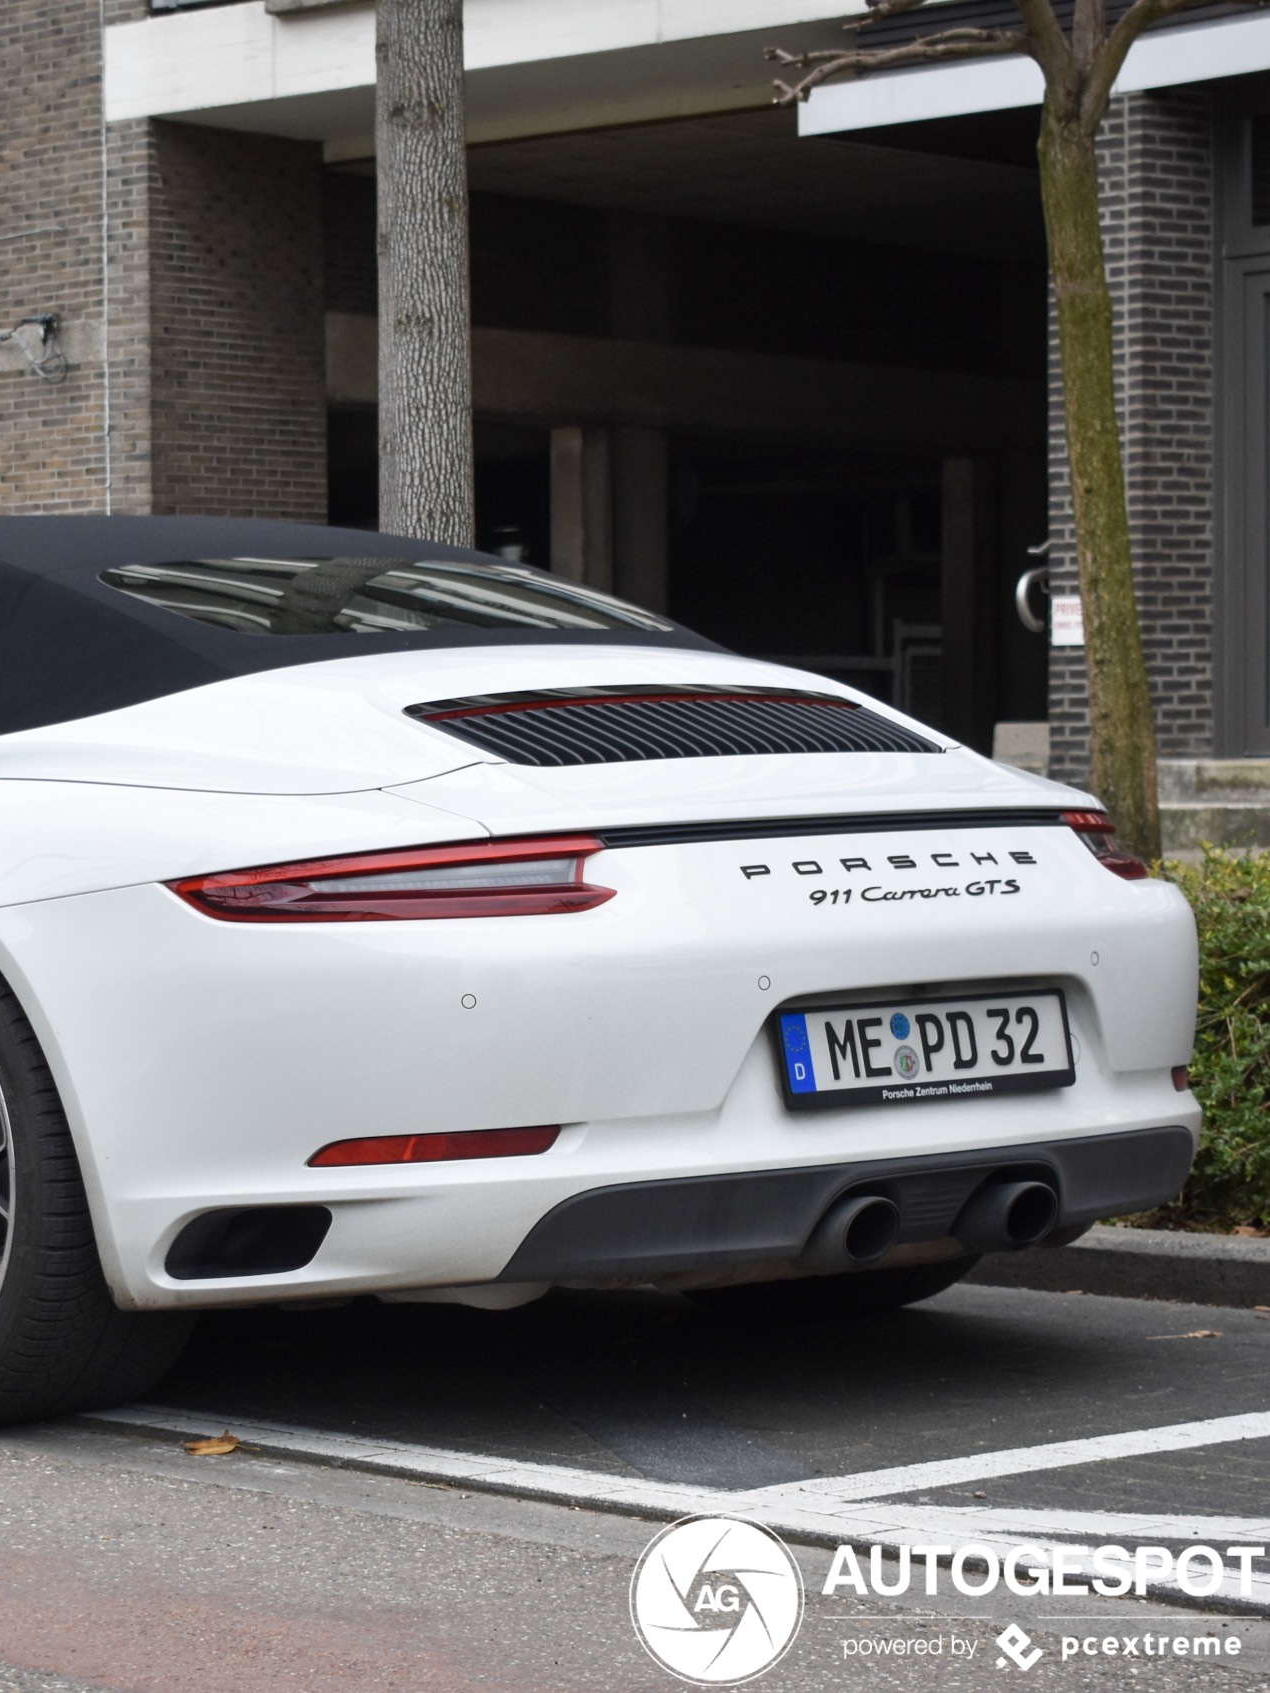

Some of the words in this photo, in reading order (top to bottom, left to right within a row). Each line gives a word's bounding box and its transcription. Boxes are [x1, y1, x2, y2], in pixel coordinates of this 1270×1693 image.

[740, 851, 1037, 880] PORSCHE
[809, 889, 853, 906] 911
[861, 886, 961, 902] Carrera
[965, 879, 1021, 896] GTS
[825, 1017, 892, 1081] ME
[915, 1011, 978, 1072] PD
[986, 1006, 1045, 1066] 32
[794, 1062, 806, 1080] D
[882, 1089, 914, 1100] Porsche
[915, 1084, 948, 1097] Zentrum
[949, 1081, 993, 1094] Niederrhein
